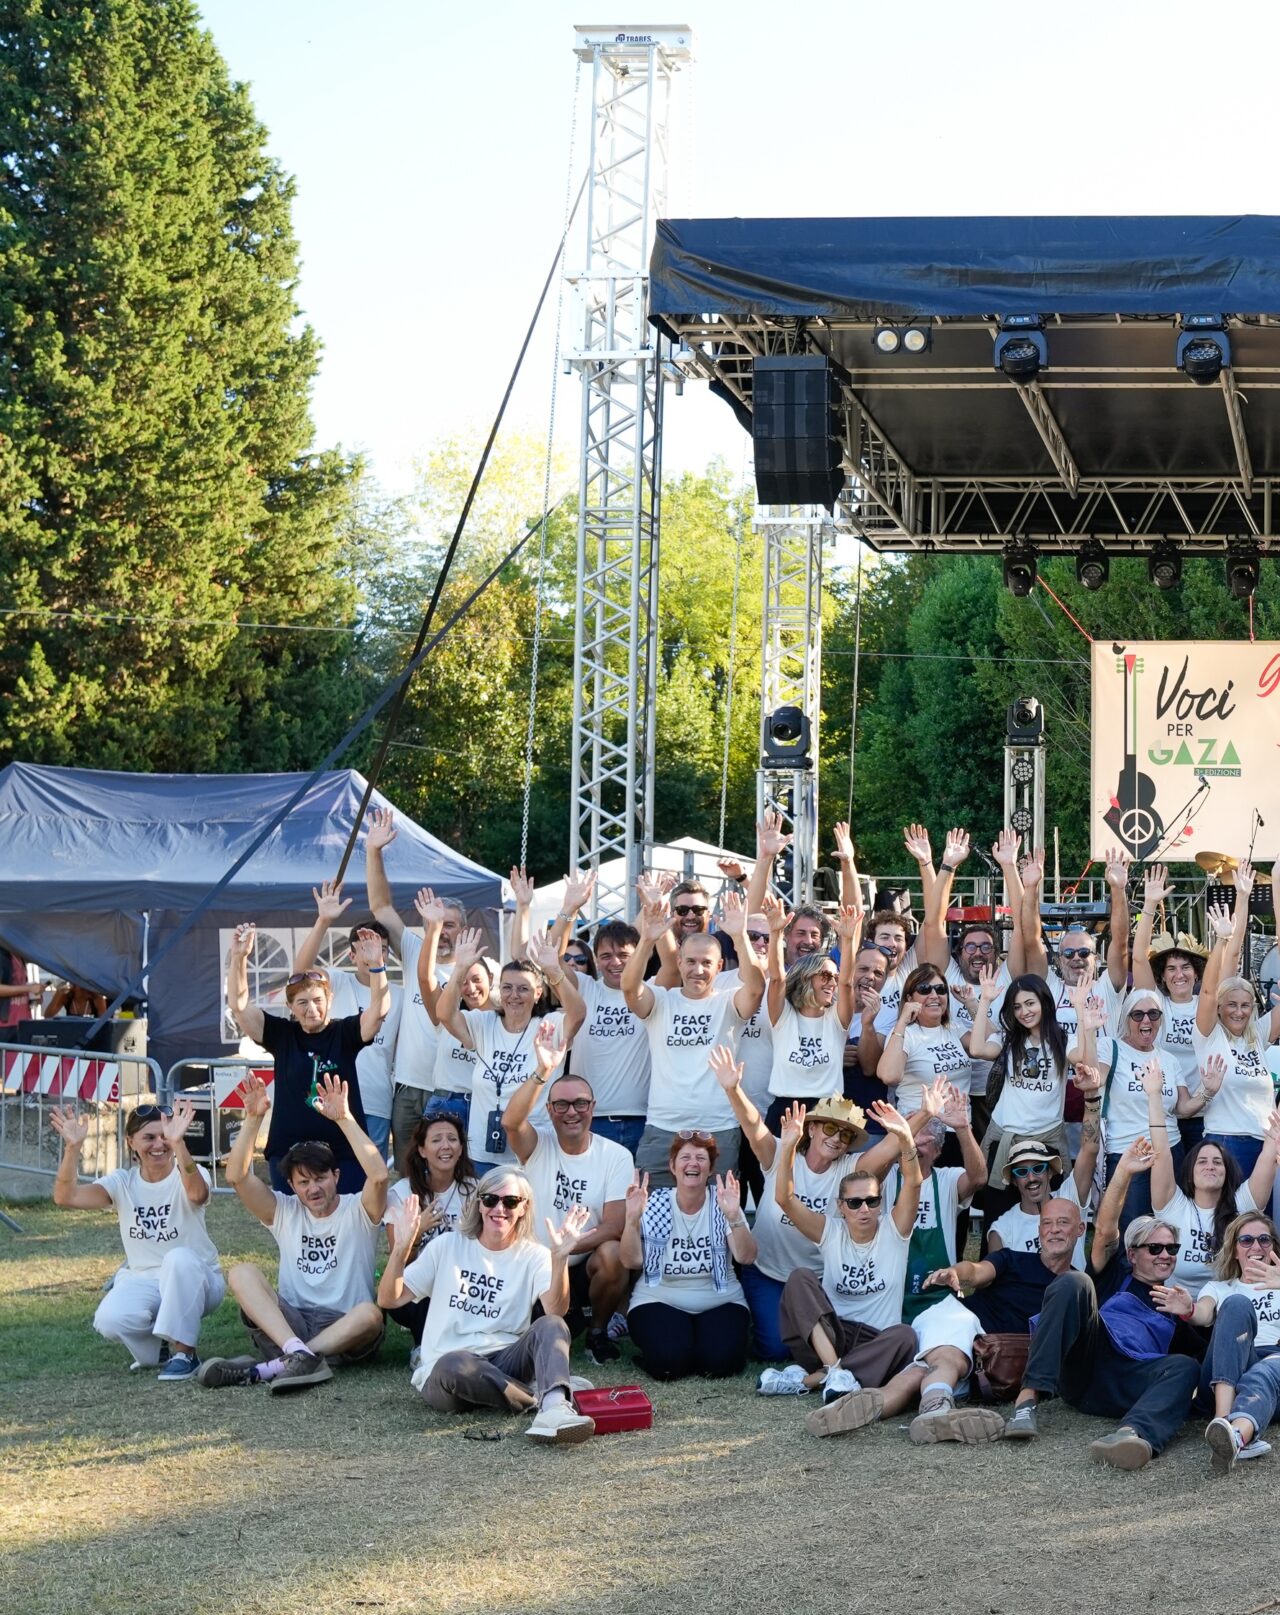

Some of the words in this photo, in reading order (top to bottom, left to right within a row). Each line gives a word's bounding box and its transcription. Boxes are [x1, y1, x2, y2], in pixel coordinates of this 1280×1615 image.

[1156, 654, 1236, 722] Voci
[1167, 723, 1194, 736] PER
[1147, 738, 1242, 766] GAZA
[596, 1015, 630, 1026] LOVE
[588, 1024, 635, 1037] EducAid
[674, 1025, 709, 1036] LOVE
[798, 1036, 823, 1047] EAC
[1165, 1033, 1193, 1046] Educ
[451, 1048, 477, 1064] Educ
[788, 1050, 830, 1068] EducAid
[492, 1061, 523, 1073] LOVE
[133, 1204, 172, 1218] EACE
[302, 1234, 337, 1249] PEACE
[672, 1235, 711, 1250] PEACE
[673, 1250, 711, 1262] LOVE
[664, 1262, 713, 1275] EducAi
[460, 1270, 504, 1291] PEACE
[842, 1271, 876, 1290] LOVE
[459, 1283, 497, 1303] LOVE
[449, 1294, 502, 1319] EducAid
